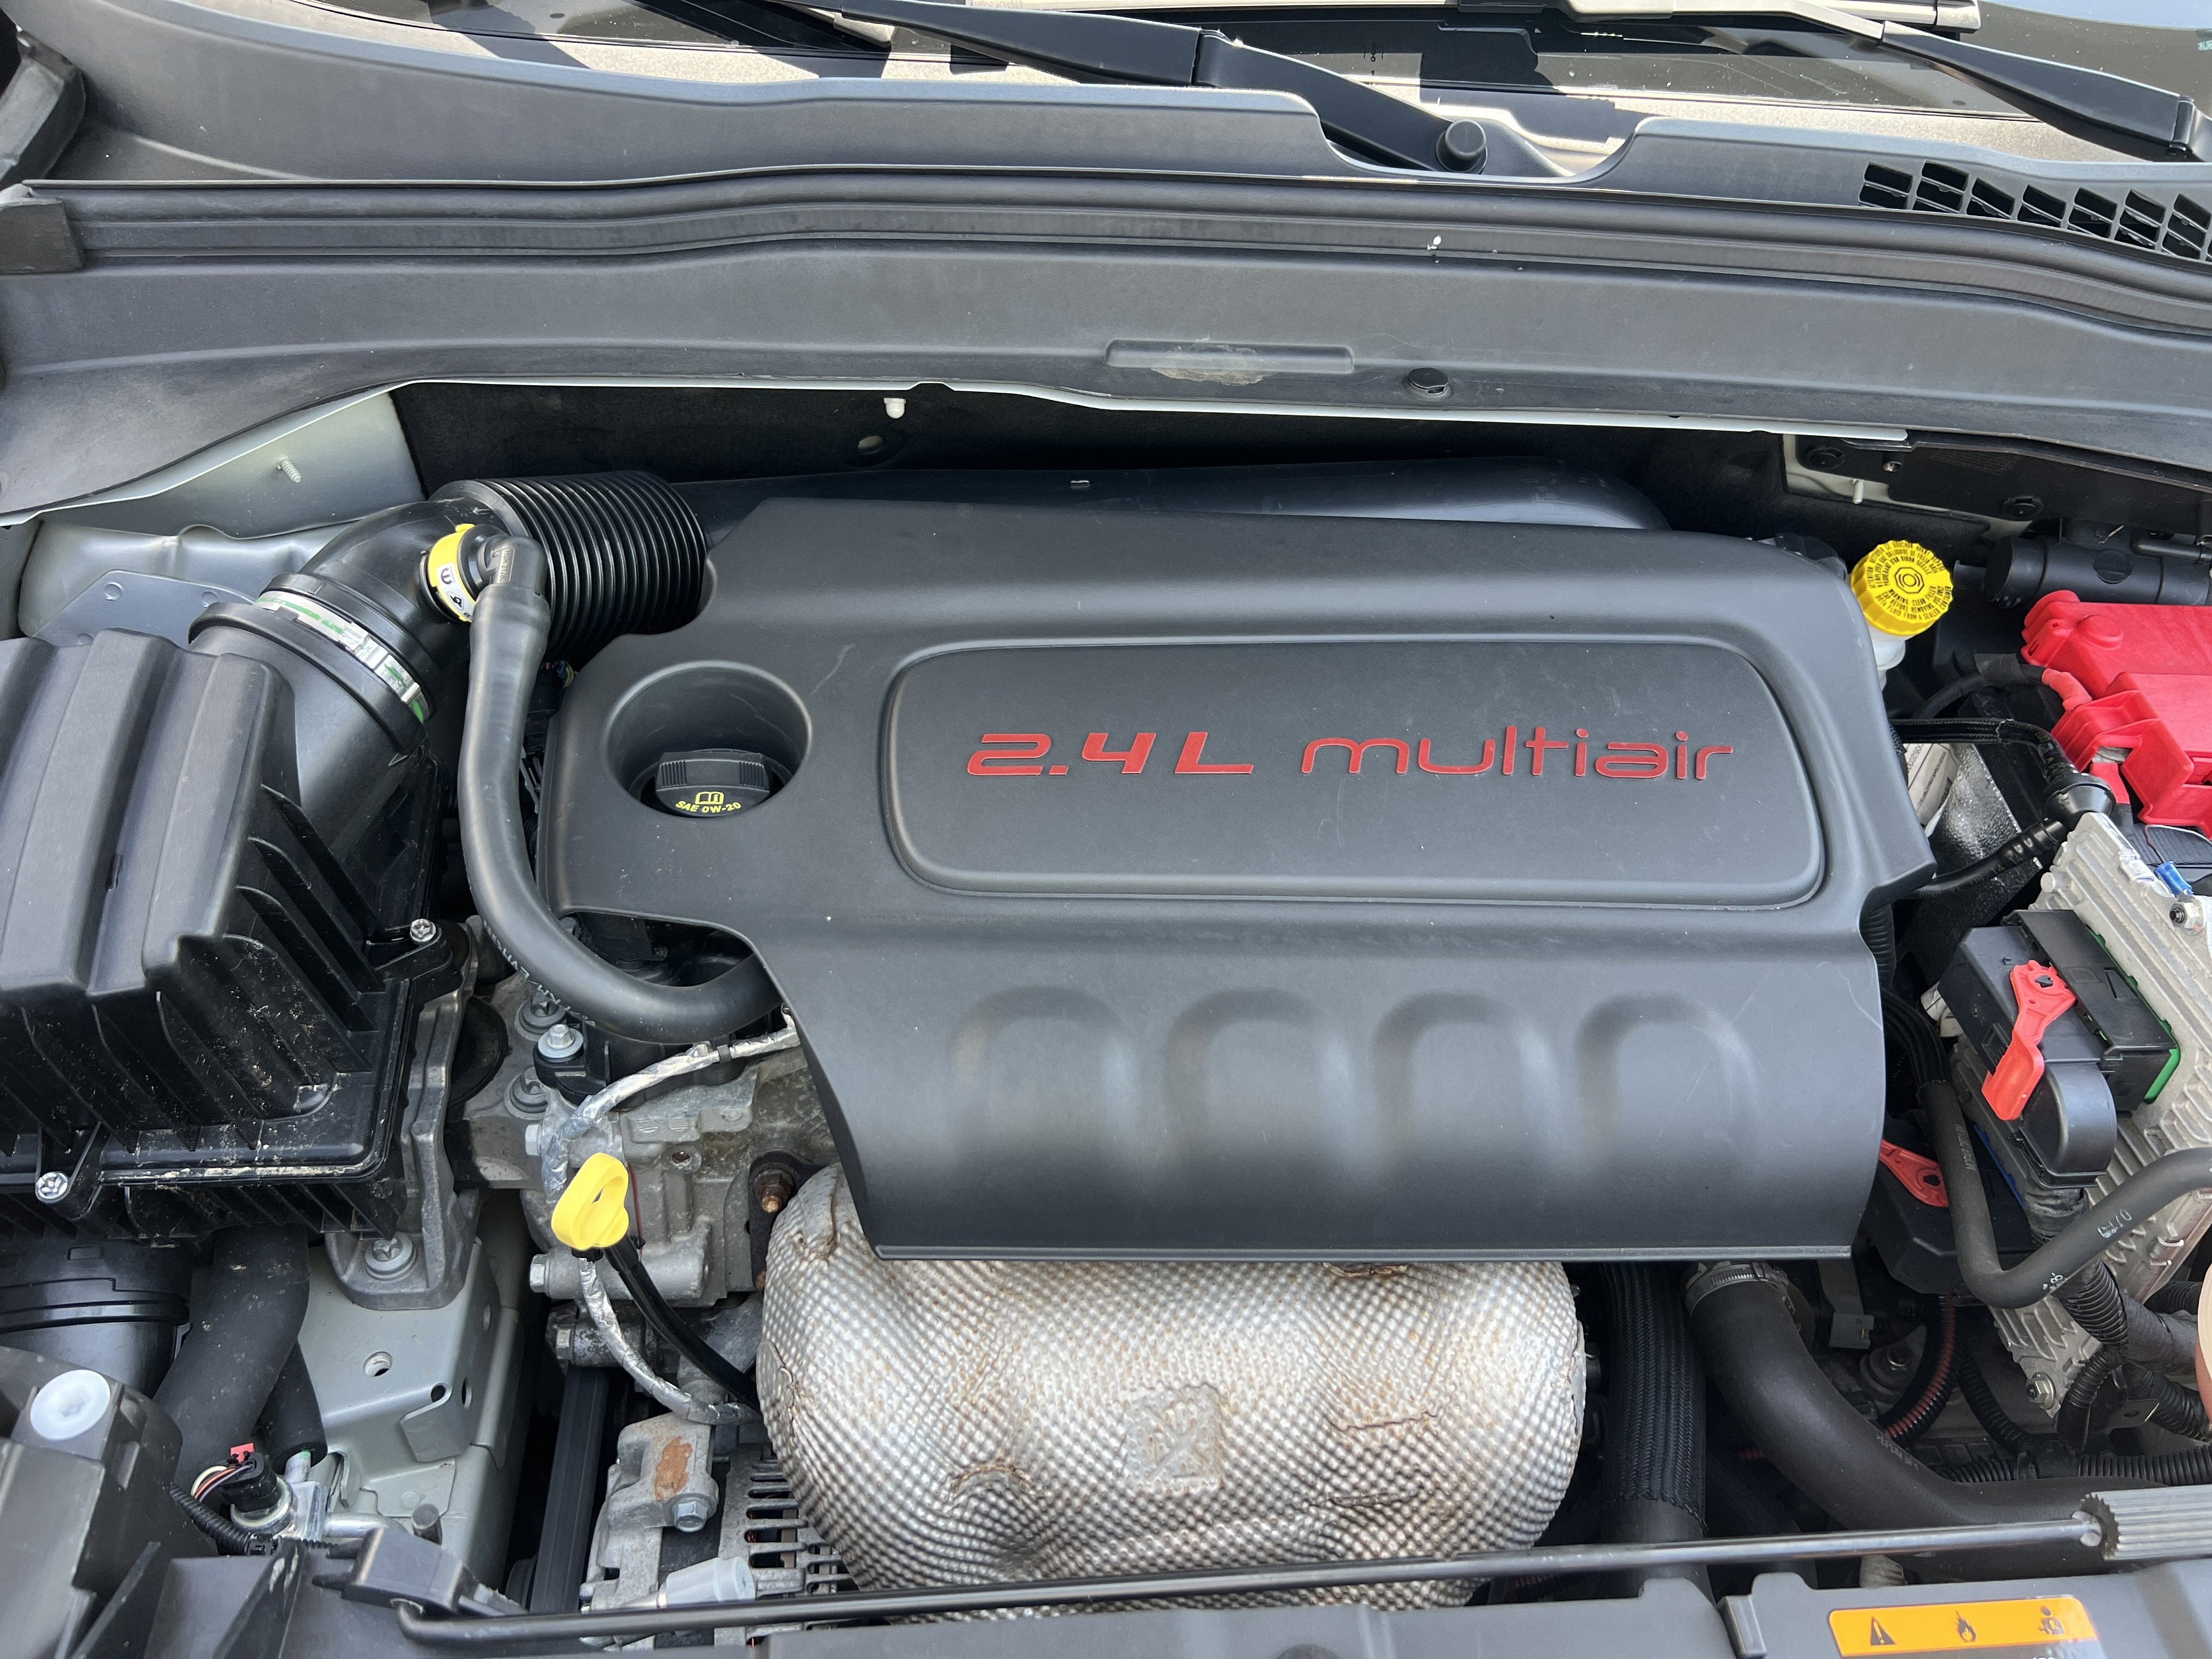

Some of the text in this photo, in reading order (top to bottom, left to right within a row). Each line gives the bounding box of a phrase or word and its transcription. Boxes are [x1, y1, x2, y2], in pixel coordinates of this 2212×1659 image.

[1301, 725, 1734, 780] multiair
[675, 800, 742, 813] SAE 0W-20
